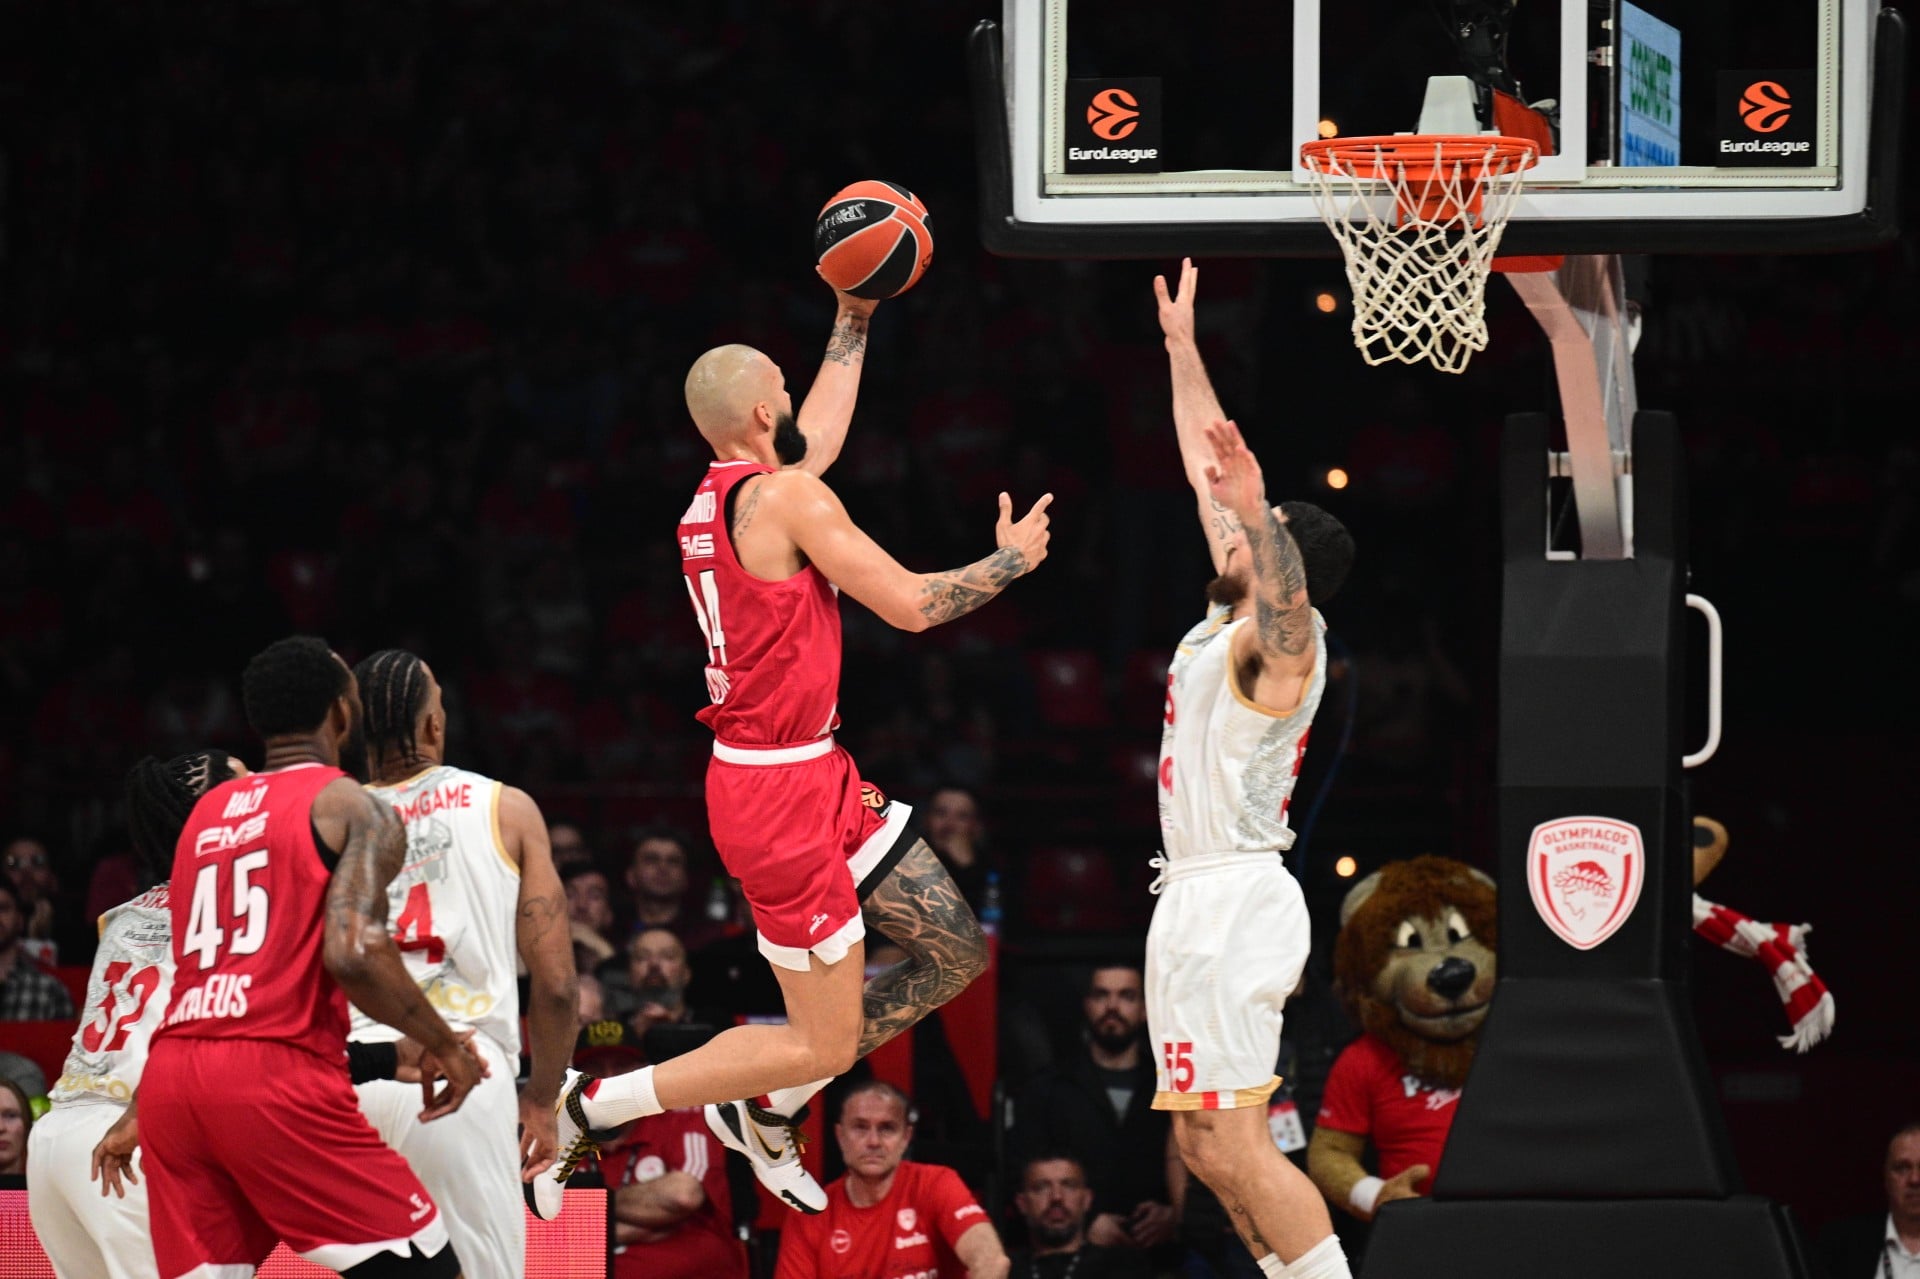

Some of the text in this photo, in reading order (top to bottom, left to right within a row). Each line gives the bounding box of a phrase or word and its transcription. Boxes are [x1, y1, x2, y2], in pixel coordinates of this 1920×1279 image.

[1069, 147, 1158, 163] EuroLeague
[1720, 140, 1810, 156] EuroLeague
[1543, 827, 1629, 846] OLYMPIACOS
[1555, 841, 1617, 855] BASKETBALL
[183, 849, 269, 970] 45
[392, 881, 446, 965] 4
[82, 961, 160, 1053] 32
